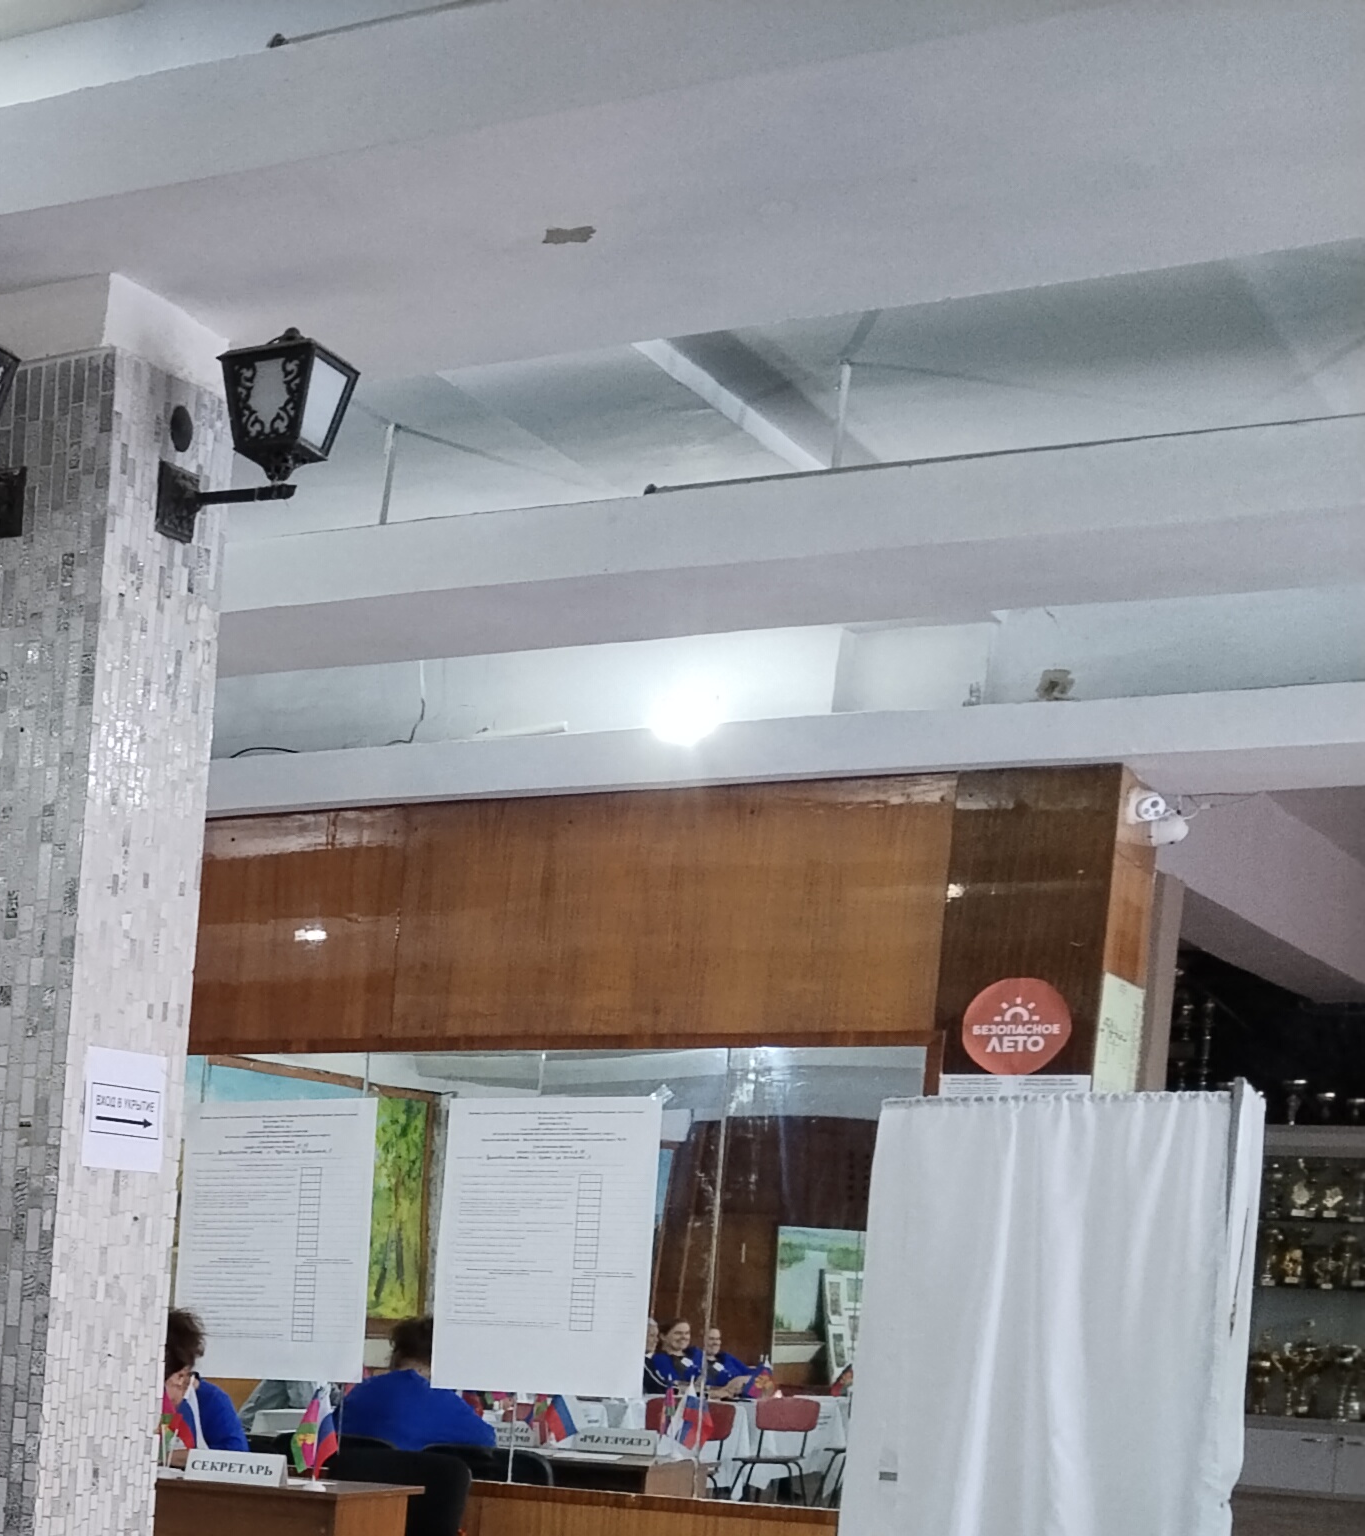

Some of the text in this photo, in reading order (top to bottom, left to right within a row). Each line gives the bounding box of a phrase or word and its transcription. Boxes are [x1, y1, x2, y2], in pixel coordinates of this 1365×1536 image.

[972, 1024, 1061, 1035] БЕЗОПАСНОЕ
[985, 1036, 1045, 1053] ЛЕТО
[191, 1460, 273, 1476] СЕКРЕТАРЬ
